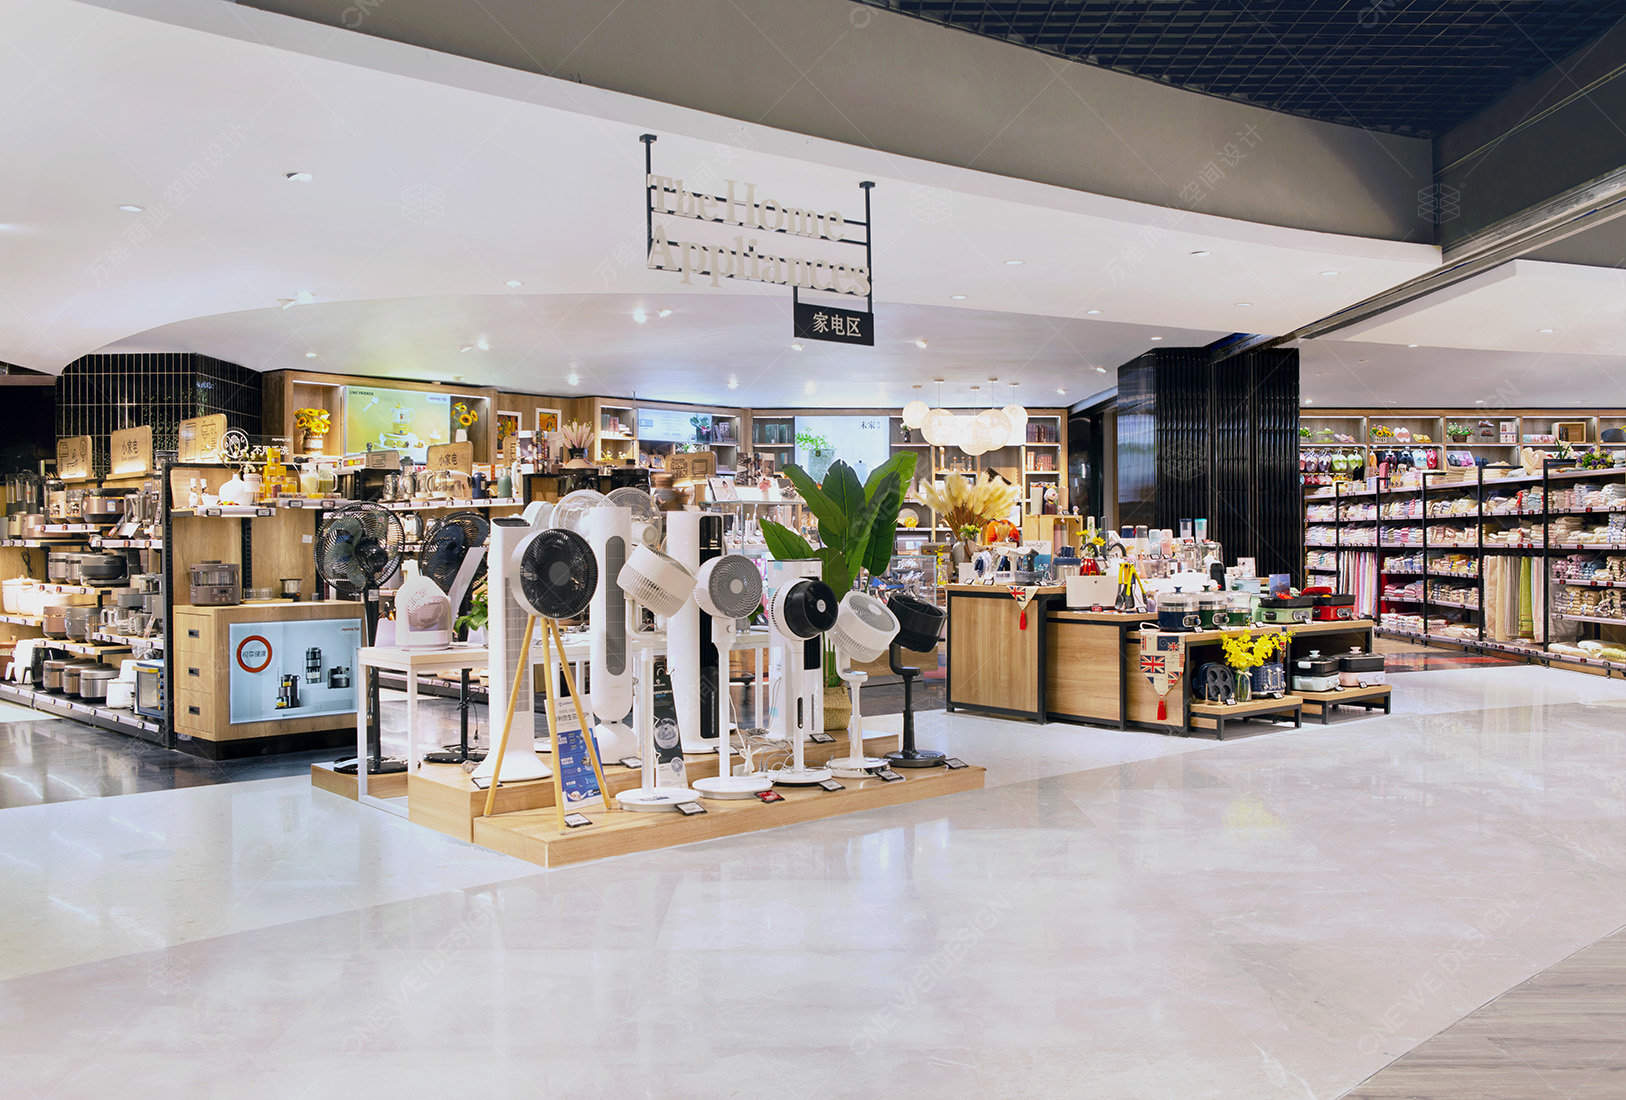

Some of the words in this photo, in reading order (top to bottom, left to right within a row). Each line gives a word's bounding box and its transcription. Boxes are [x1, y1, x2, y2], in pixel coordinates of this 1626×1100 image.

[647, 173, 719, 221] The
[724, 178, 846, 242] Home
[646, 224, 872, 298] Appliances
[812, 311, 862, 338] 家电区
